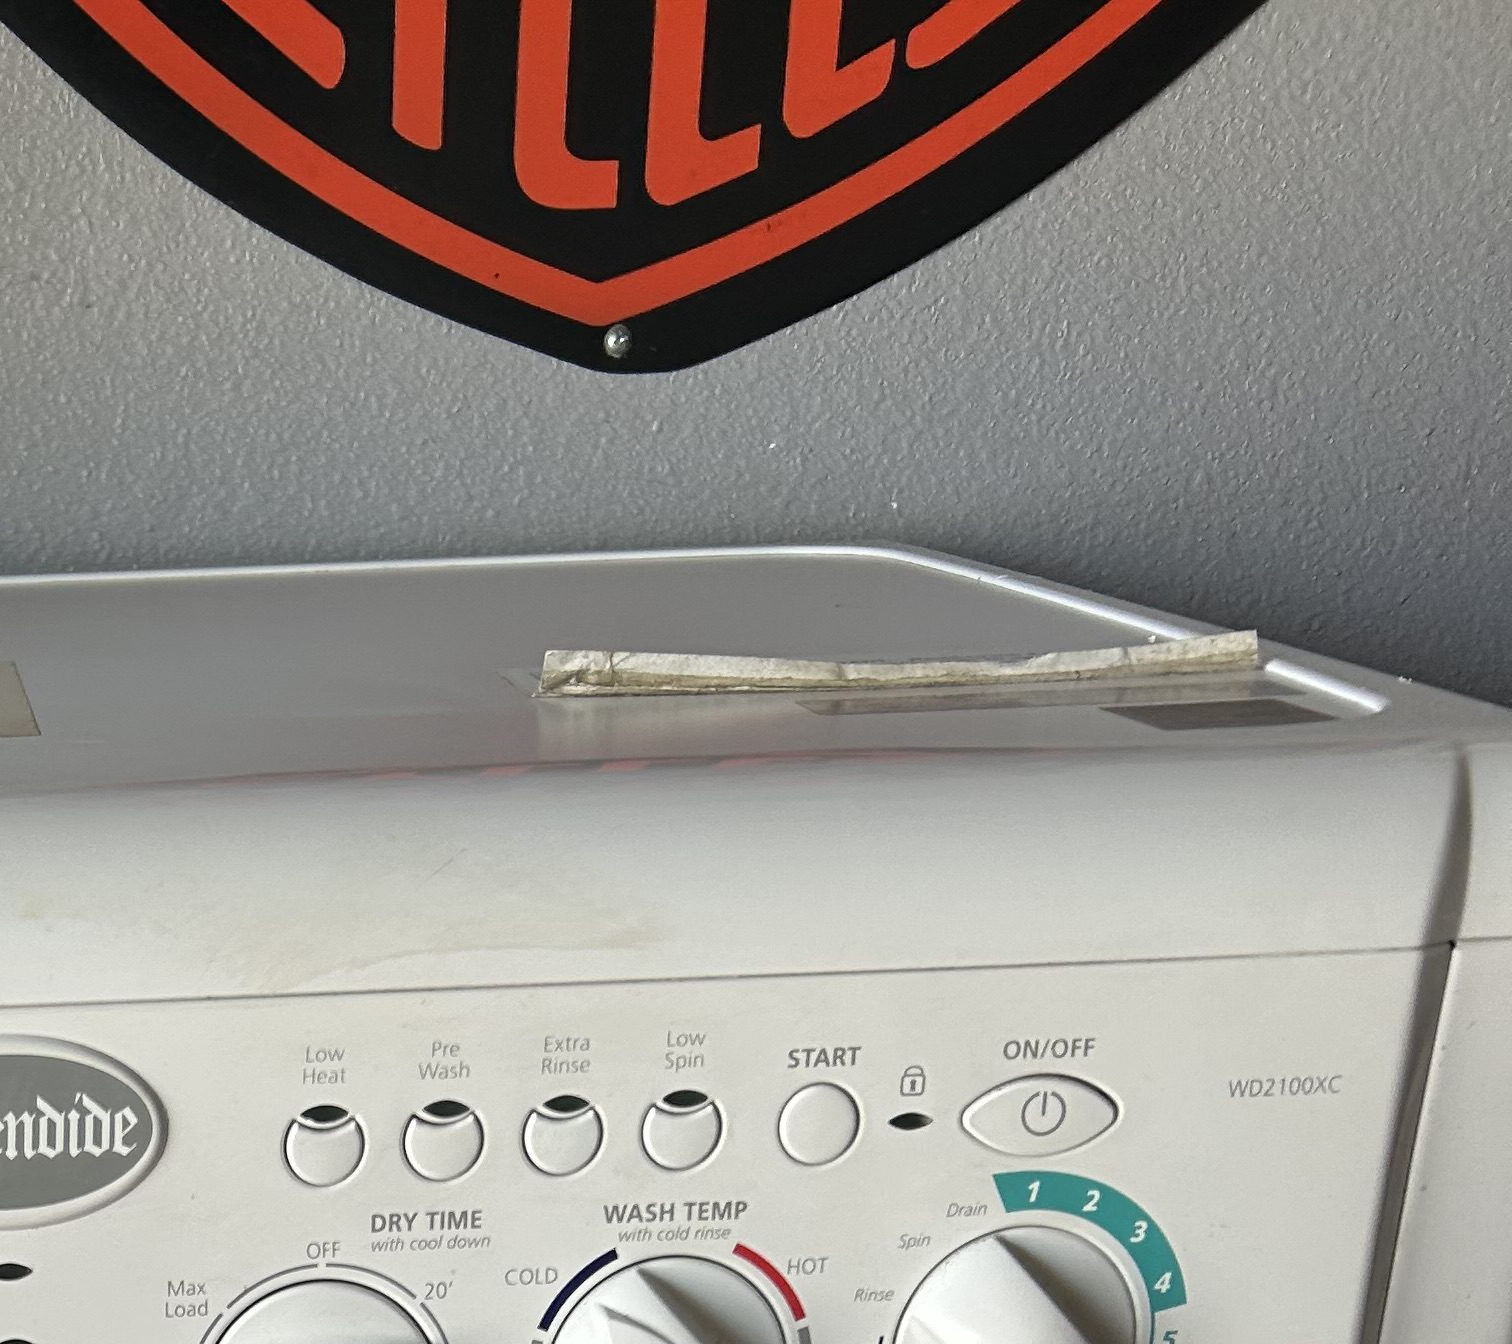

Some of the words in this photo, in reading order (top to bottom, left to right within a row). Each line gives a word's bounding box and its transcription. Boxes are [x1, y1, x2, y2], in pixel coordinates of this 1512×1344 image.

[431, 1040, 461, 1058] Pre
[543, 1035, 590, 1053] Extra
[666, 1030, 707, 1048] Low
[1002, 1037, 1096, 1061] ON/OFF
[305, 1046, 346, 1064] Low
[664, 1051, 705, 1073] Spin
[787, 1046, 862, 1069] START
[302, 1067, 346, 1085] Heat
[418, 1060, 471, 1081] Wash
[541, 1057, 591, 1075] Rinse
[1228, 1074, 1343, 1098] WD2100XC
[1027, 1180, 1041, 1203] 1
[1081, 1189, 1101, 1212] 2
[603, 1202, 675, 1224] WASH
[683, 1200, 748, 1222] TEMP
[945, 1202, 988, 1218] Drain
[370, 1212, 419, 1234] DRY
[425, 1209, 482, 1231] TIME
[1129, 1220, 1148, 1243] 3
[371, 1235, 405, 1253] with
[409, 1234, 444, 1251] cool
[446, 1234, 491, 1250] down
[618, 1225, 653, 1243] with
[656, 1225, 691, 1242] cold
[693, 1225, 732, 1241] rinse
[897, 1233, 931, 1251] Spin
[306, 1240, 340, 1260] OFF
[786, 1256, 829, 1276] HOT
[504, 1267, 559, 1286] COLD
[1153, 1271, 1173, 1294] 4
[167, 1279, 206, 1297] Max
[853, 1287, 895, 1303] Rinse
[165, 1299, 209, 1319] Load
